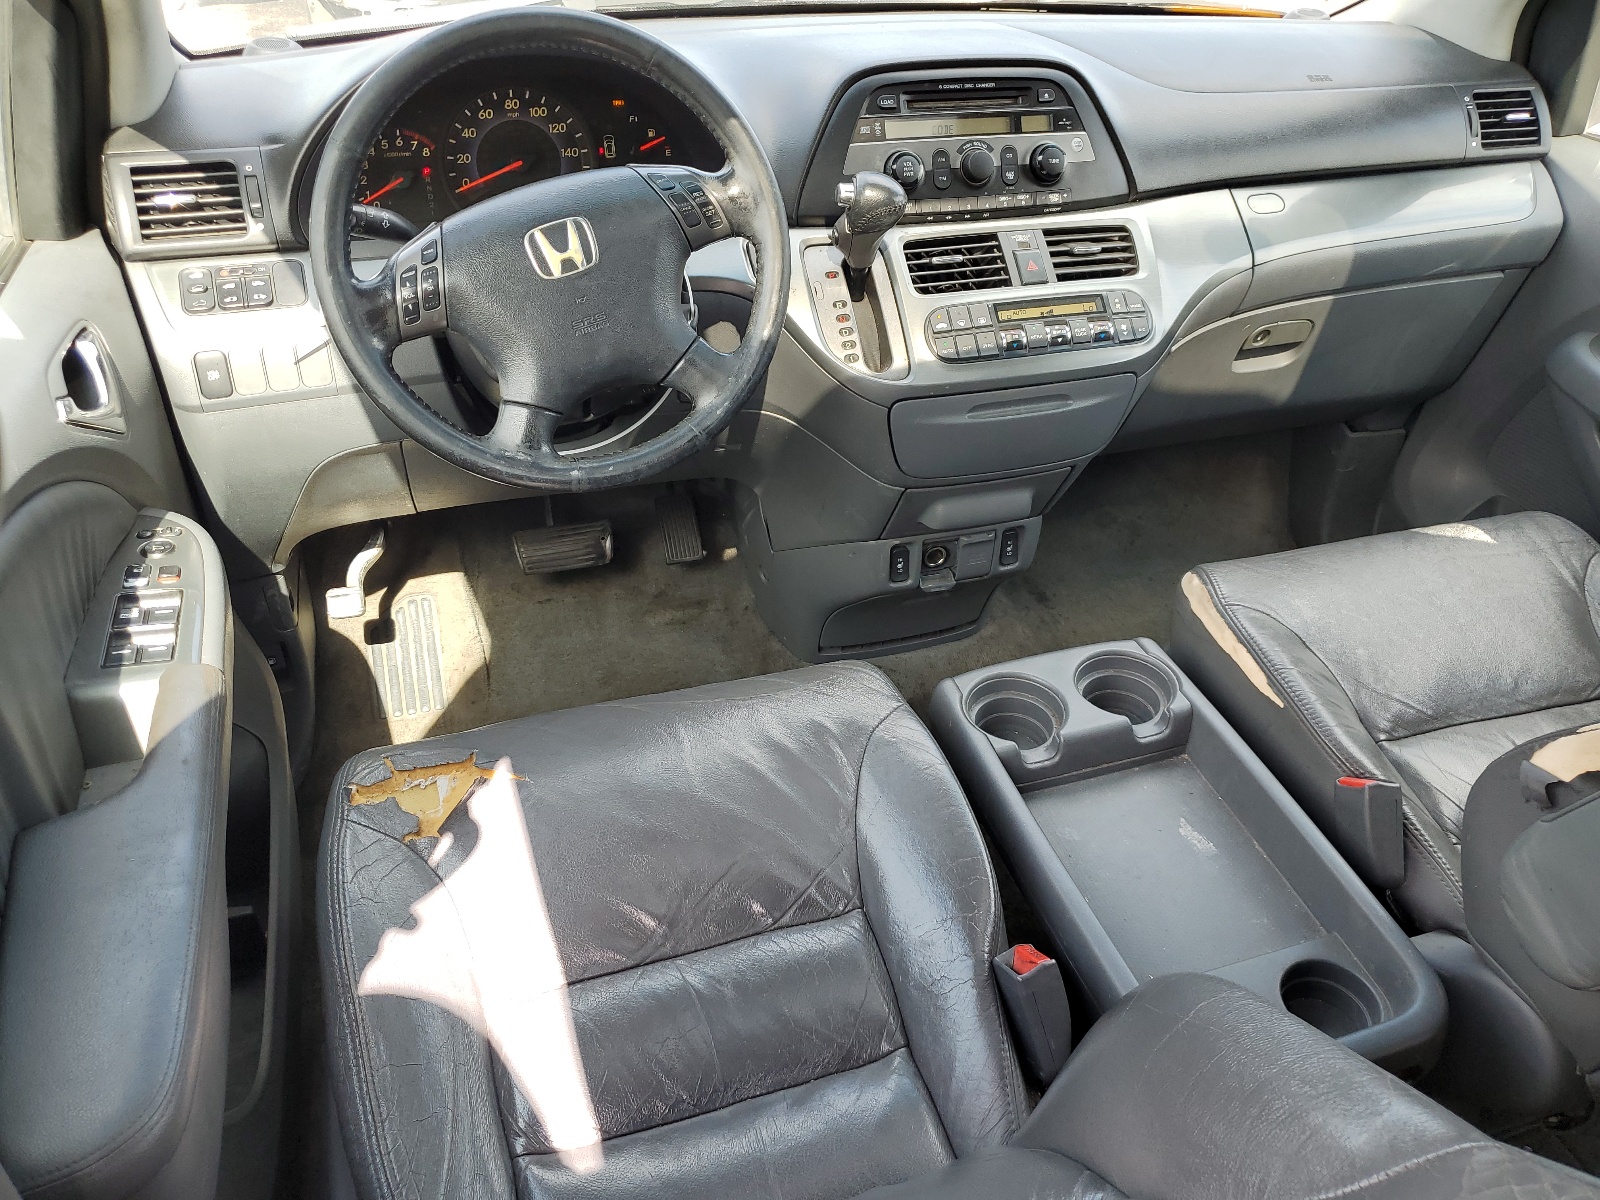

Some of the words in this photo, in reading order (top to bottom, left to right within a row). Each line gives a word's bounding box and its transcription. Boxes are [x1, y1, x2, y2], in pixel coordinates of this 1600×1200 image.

[504, 99, 520, 110] 80
[478, 109, 494, 120] 60
[529, 106, 548, 117] 100
[548, 122, 567, 133] 120
[932, 124, 954, 135] CODE
[461, 128, 477, 138] 40
[381, 139, 389, 149] 5
[396, 136, 403, 147] 6
[410, 140, 418, 150] 7
[368, 147, 375, 156] 4
[422, 147, 430, 157] 8
[560, 147, 579, 157] 140
[456, 153, 471, 164] 20
[360, 175, 368, 185] 2
[462, 178, 470, 187] 0
[365, 190, 370, 199] 1
[572, 311, 607, 327] SRS
